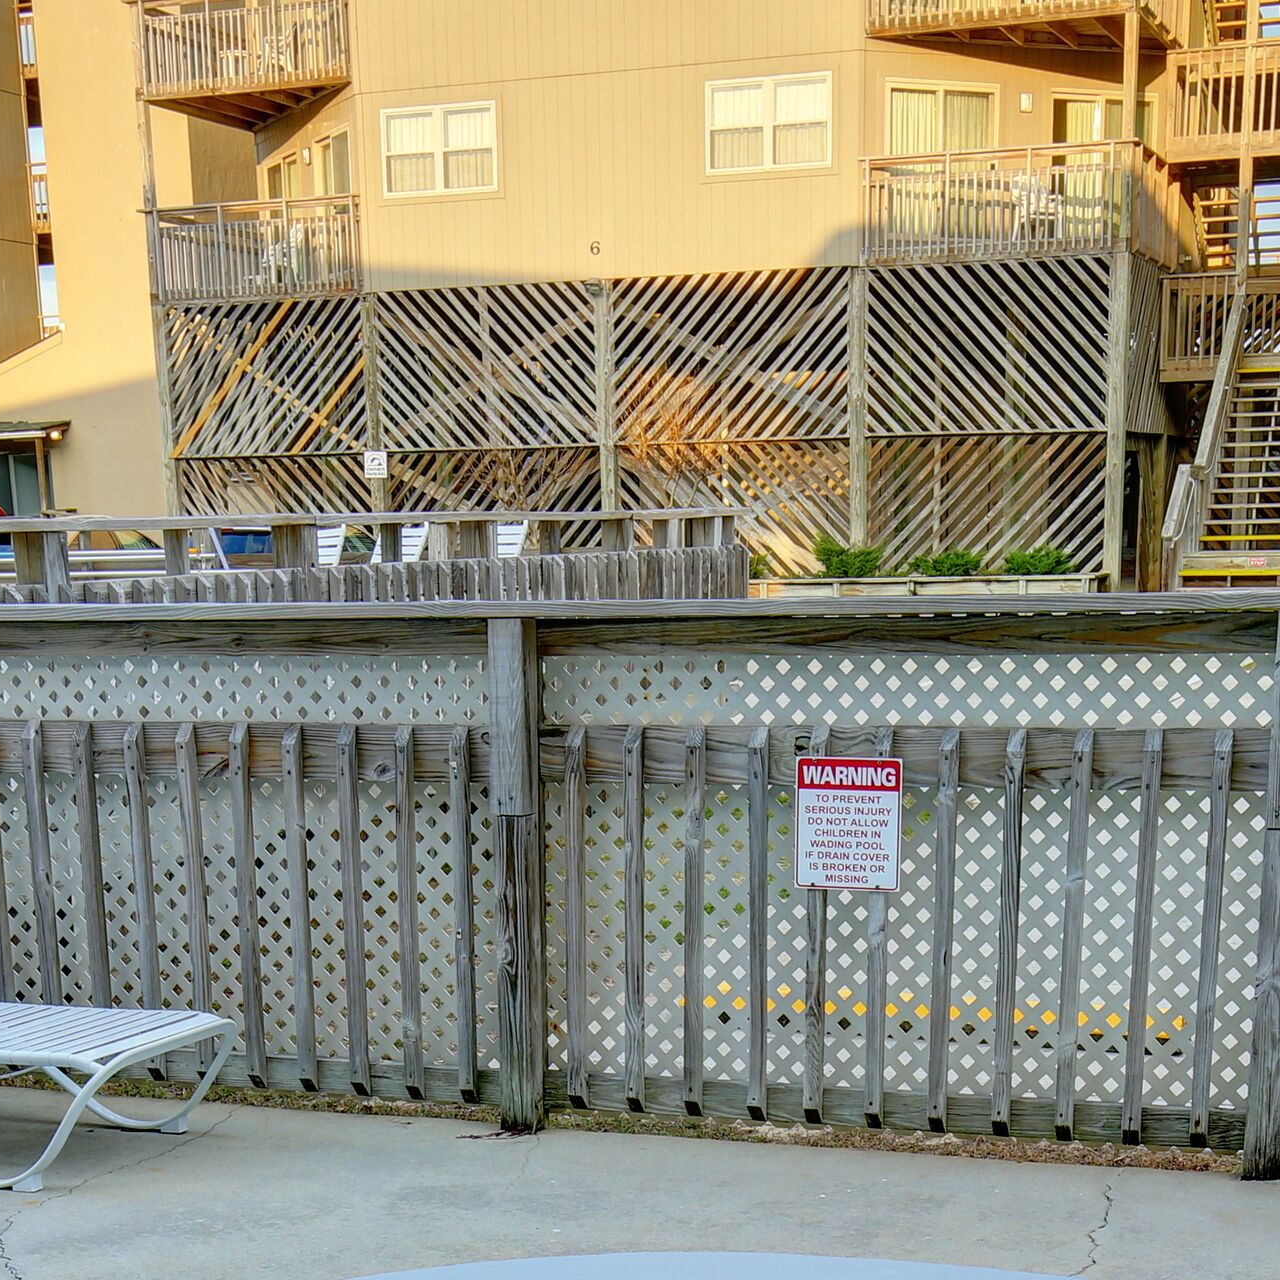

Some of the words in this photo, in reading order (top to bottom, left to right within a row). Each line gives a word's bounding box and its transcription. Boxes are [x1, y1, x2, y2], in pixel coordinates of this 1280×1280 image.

[590, 240, 601, 256] 6
[802, 765, 896, 787] WARNING
[816, 794, 830, 803] TO
[832, 794, 882, 804] PREVENT
[804, 806, 851, 815] SERIOUS
[854, 807, 892, 817] INJURY
[808, 817, 823, 826] DO
[826, 817, 848, 826] NOT
[851, 818, 889, 828] ALLOW
[814, 828, 868, 838] CHILDREN
[871, 830, 881, 838] IN
[810, 840, 852, 849] WADING
[856, 841, 885, 850] POOL
[817, 852, 849, 860] DRAIN
[853, 853, 890, 862] COVER
[822, 863, 867, 872] BROKEN
[870, 865, 885, 873] OR
[825, 874, 869, 884] MISSING
